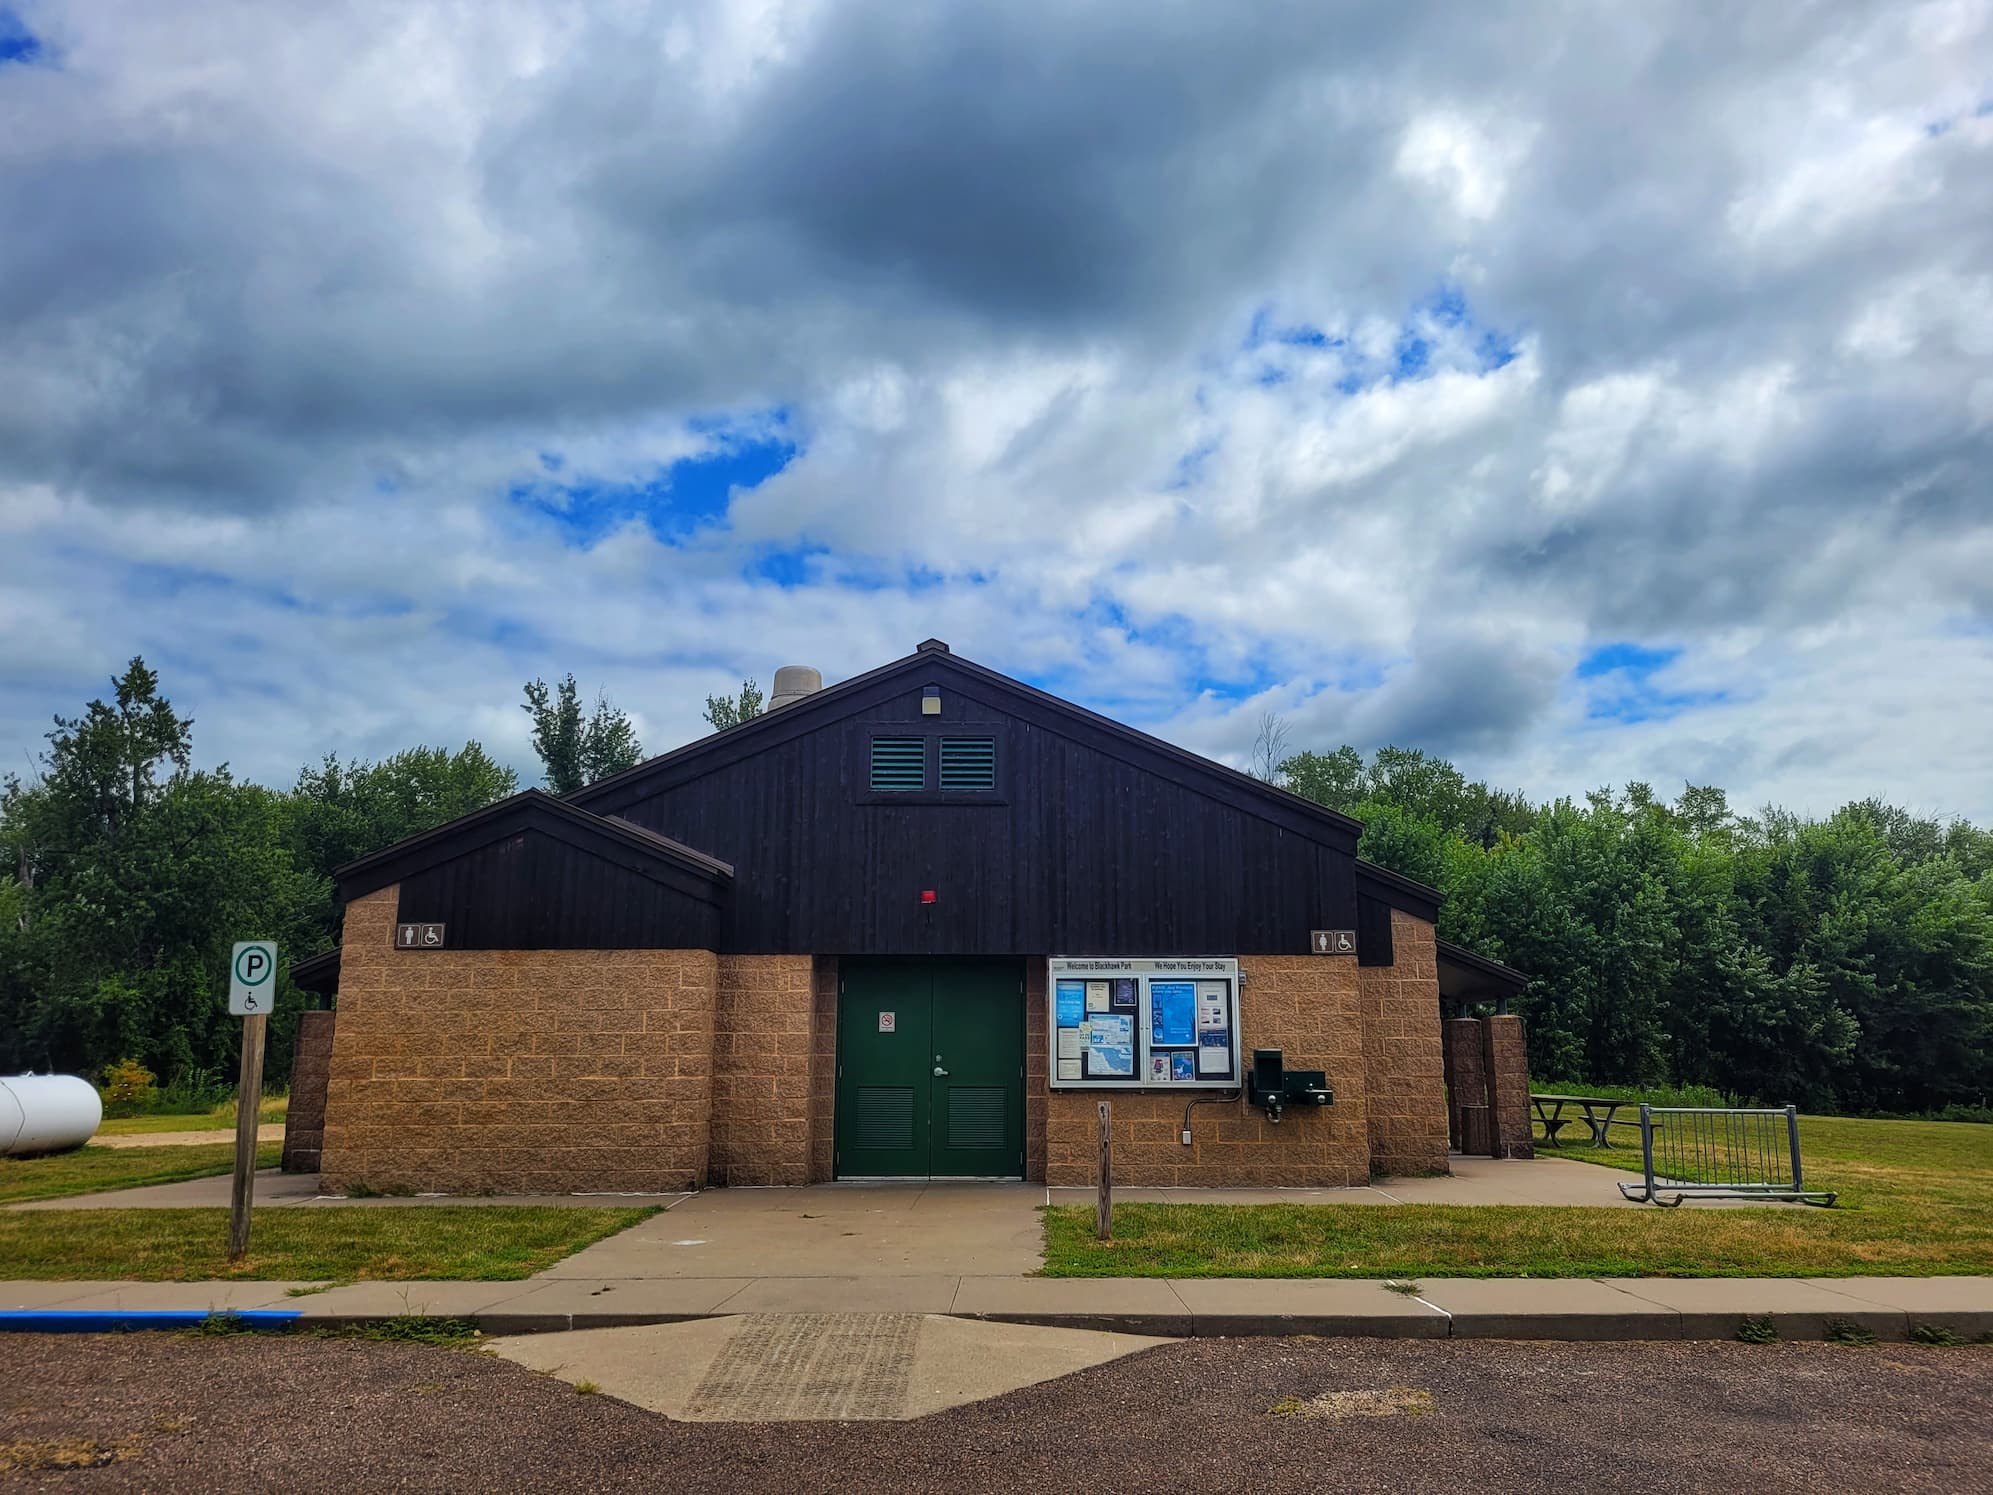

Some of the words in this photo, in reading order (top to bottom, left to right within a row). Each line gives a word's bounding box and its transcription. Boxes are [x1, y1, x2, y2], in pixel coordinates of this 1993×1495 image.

[247, 954, 263, 977] P
[1067, 961, 1089, 970] Welcome
[1095, 961, 1121, 970] Blackhawk
[1121, 961, 1132, 970] Park
[1155, 961, 1163, 970] We
[1163, 961, 1176, 971] Hope
[1177, 961, 1187, 970] You
[1187, 961, 1202, 972] Enjoy
[1202, 961, 1214, 970] Your
[1215, 961, 1226, 972] Stay
